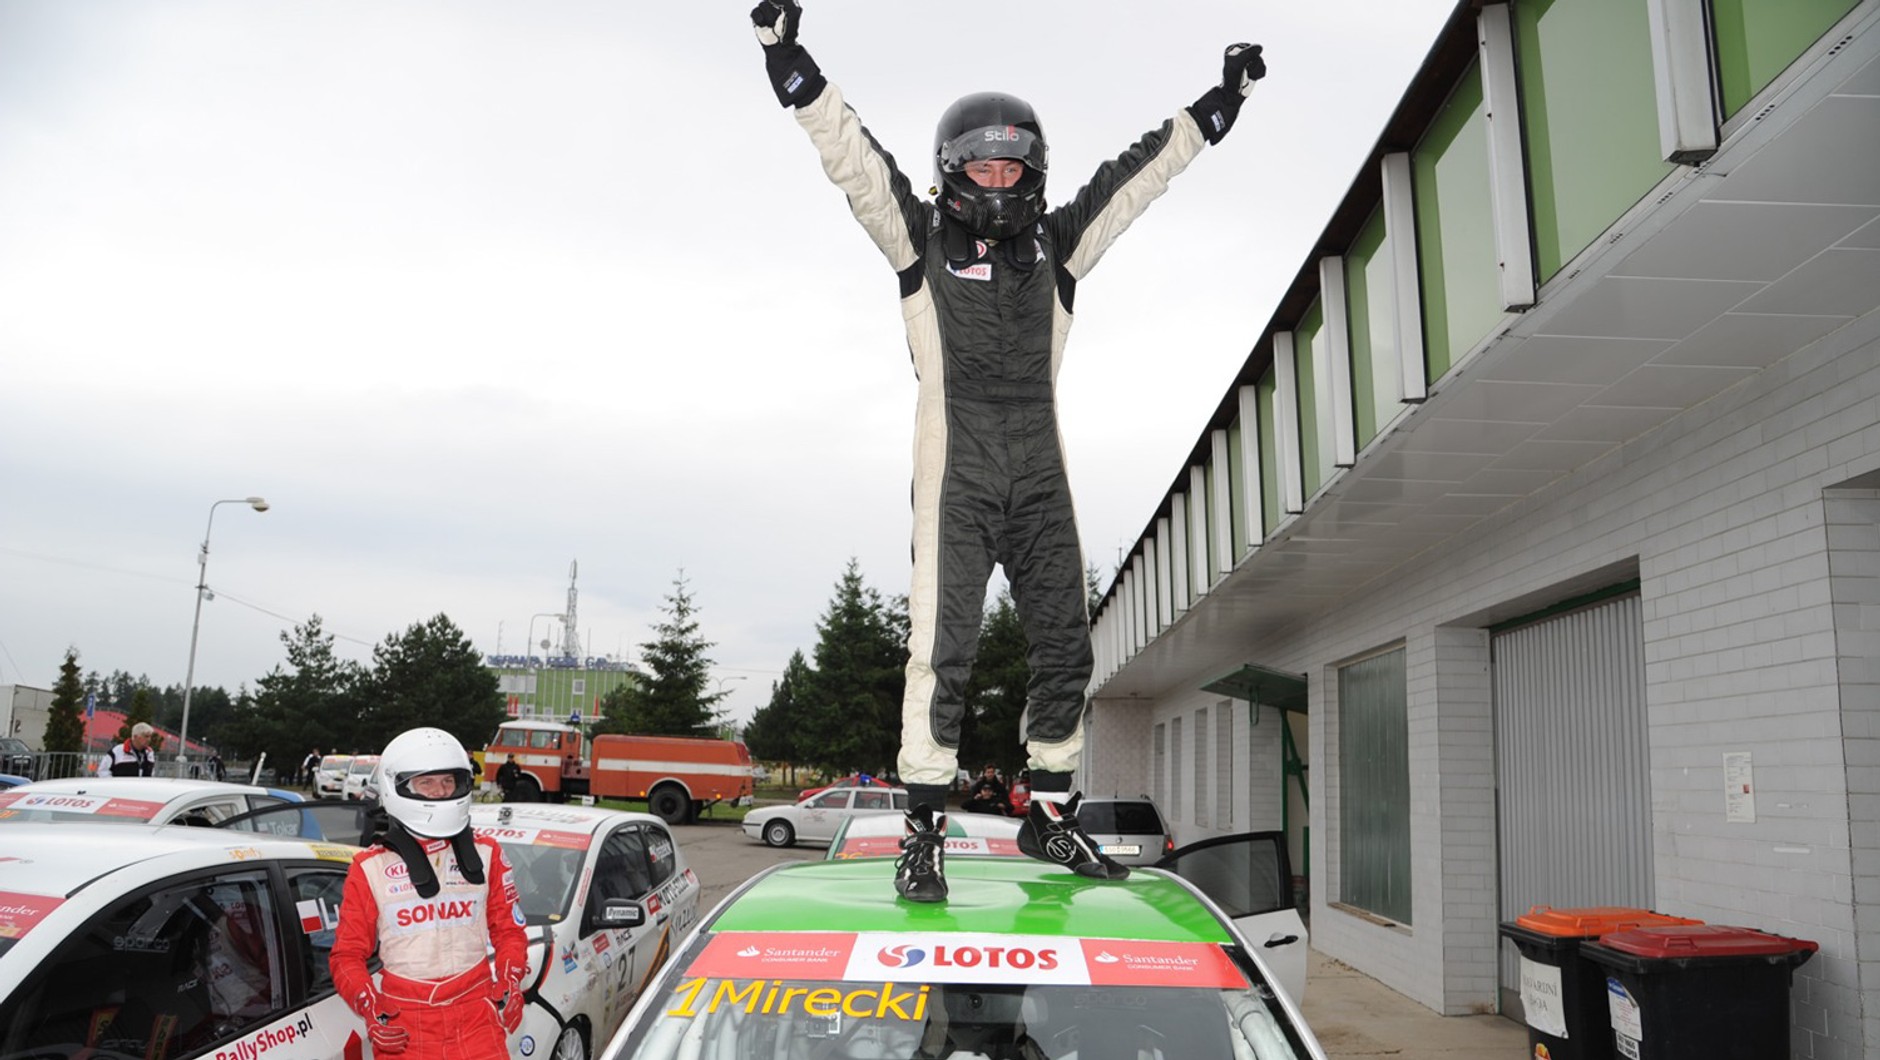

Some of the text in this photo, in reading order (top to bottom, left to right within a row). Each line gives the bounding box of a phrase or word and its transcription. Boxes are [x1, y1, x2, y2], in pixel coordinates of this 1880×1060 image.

[984, 125, 1019, 141] Stilo
[46, 797, 94, 808] LOTOS
[943, 840, 979, 850] OTOS
[397, 901, 473, 927] SONAX
[764, 946, 840, 957] Santander
[934, 945, 1058, 970] LOTOS
[1122, 953, 1199, 966] Santander
[617, 945, 637, 993] 27
